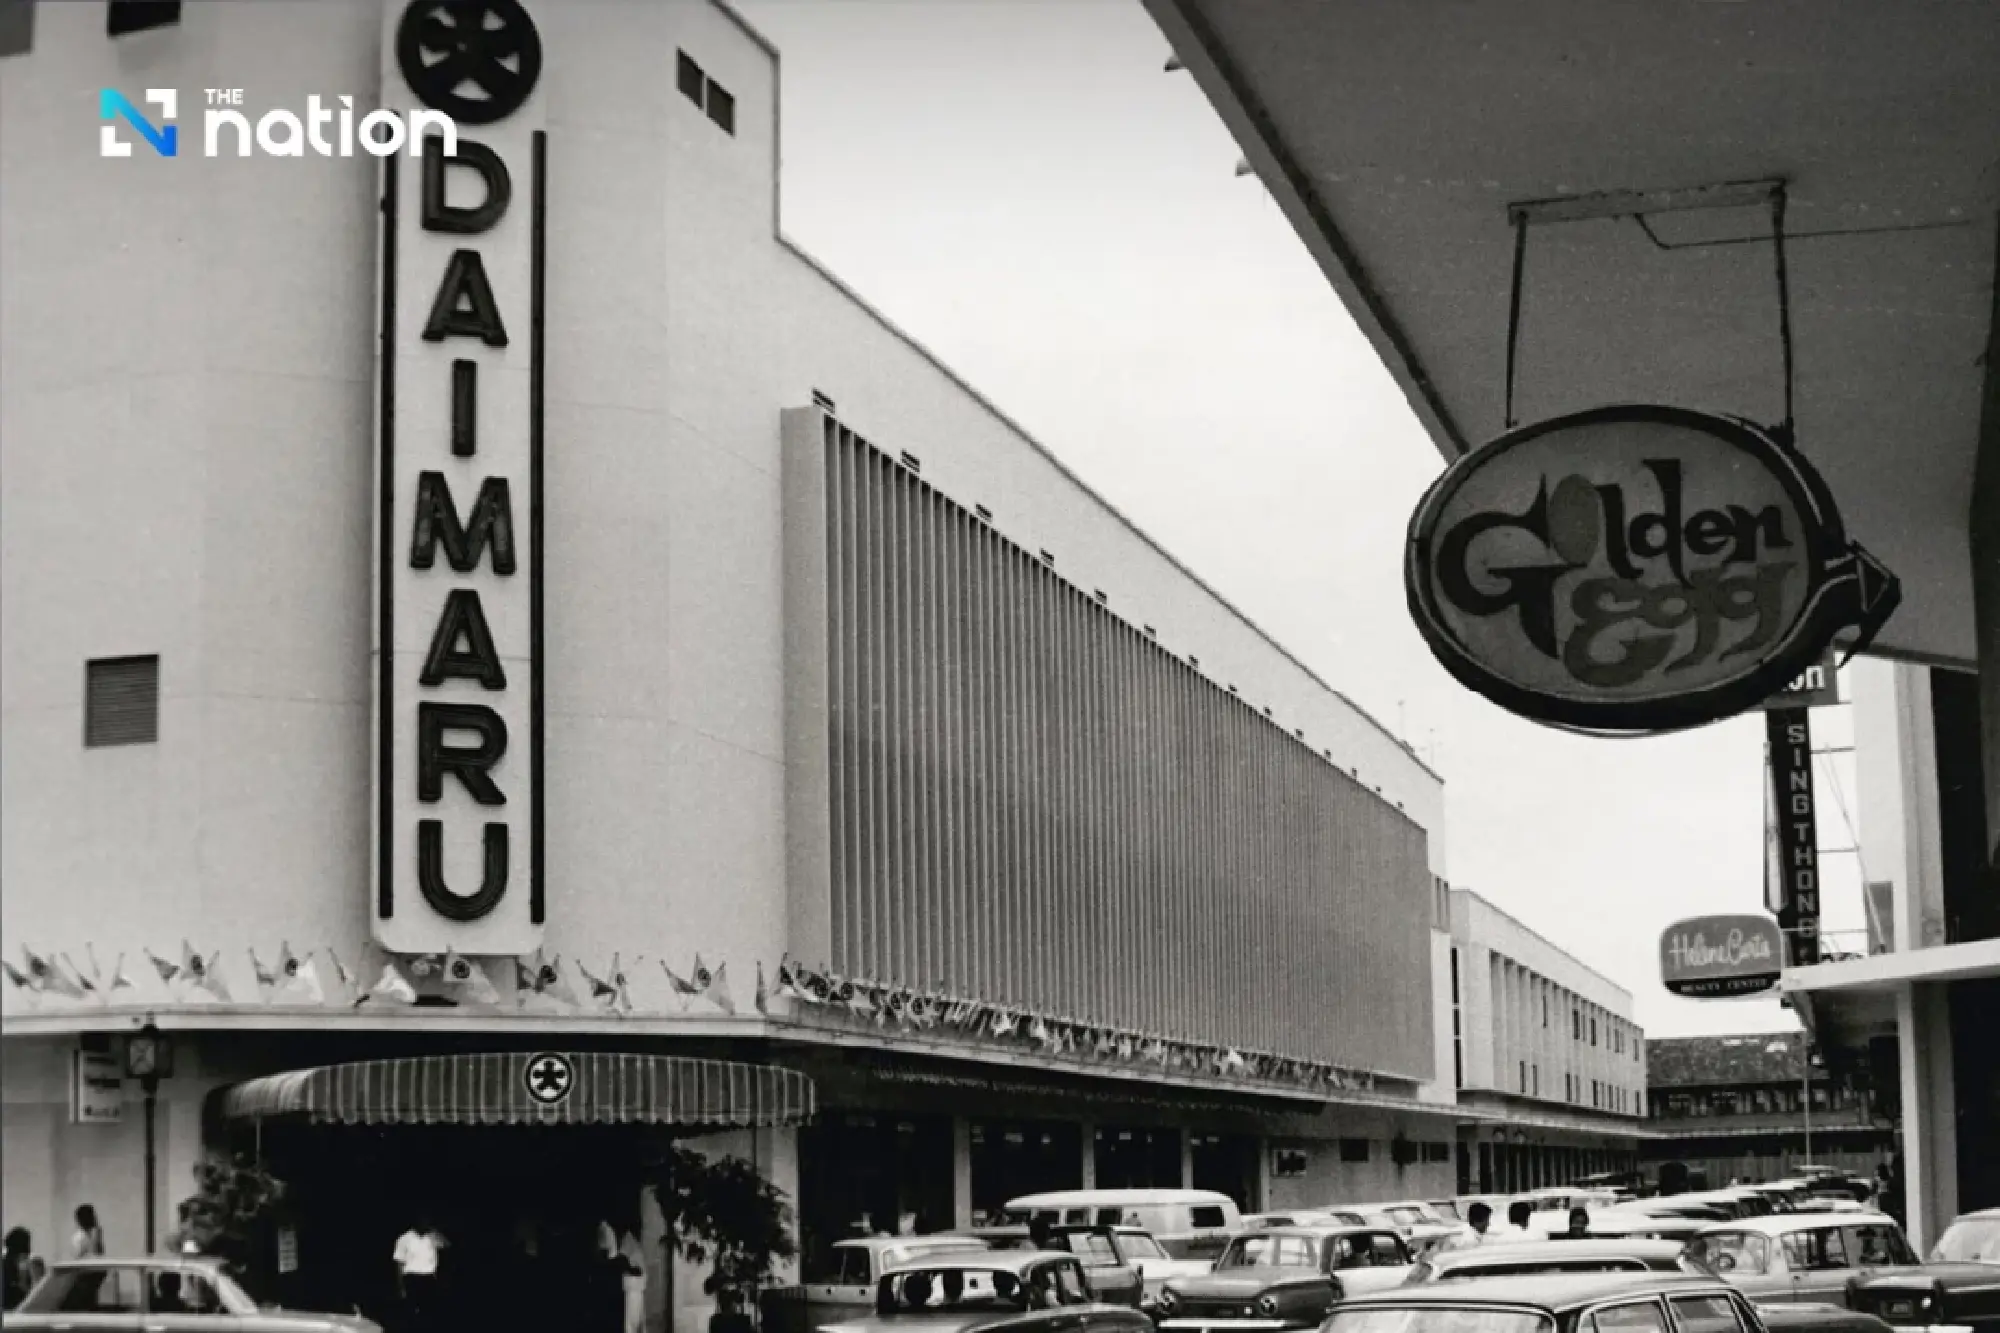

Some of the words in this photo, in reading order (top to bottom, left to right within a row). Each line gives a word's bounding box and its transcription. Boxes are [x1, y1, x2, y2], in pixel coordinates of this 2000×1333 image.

[409, 134, 517, 922] DAIMARU
[1437, 458, 1794, 659] Golden
[1786, 724, 1819, 938] SINGTHONG
